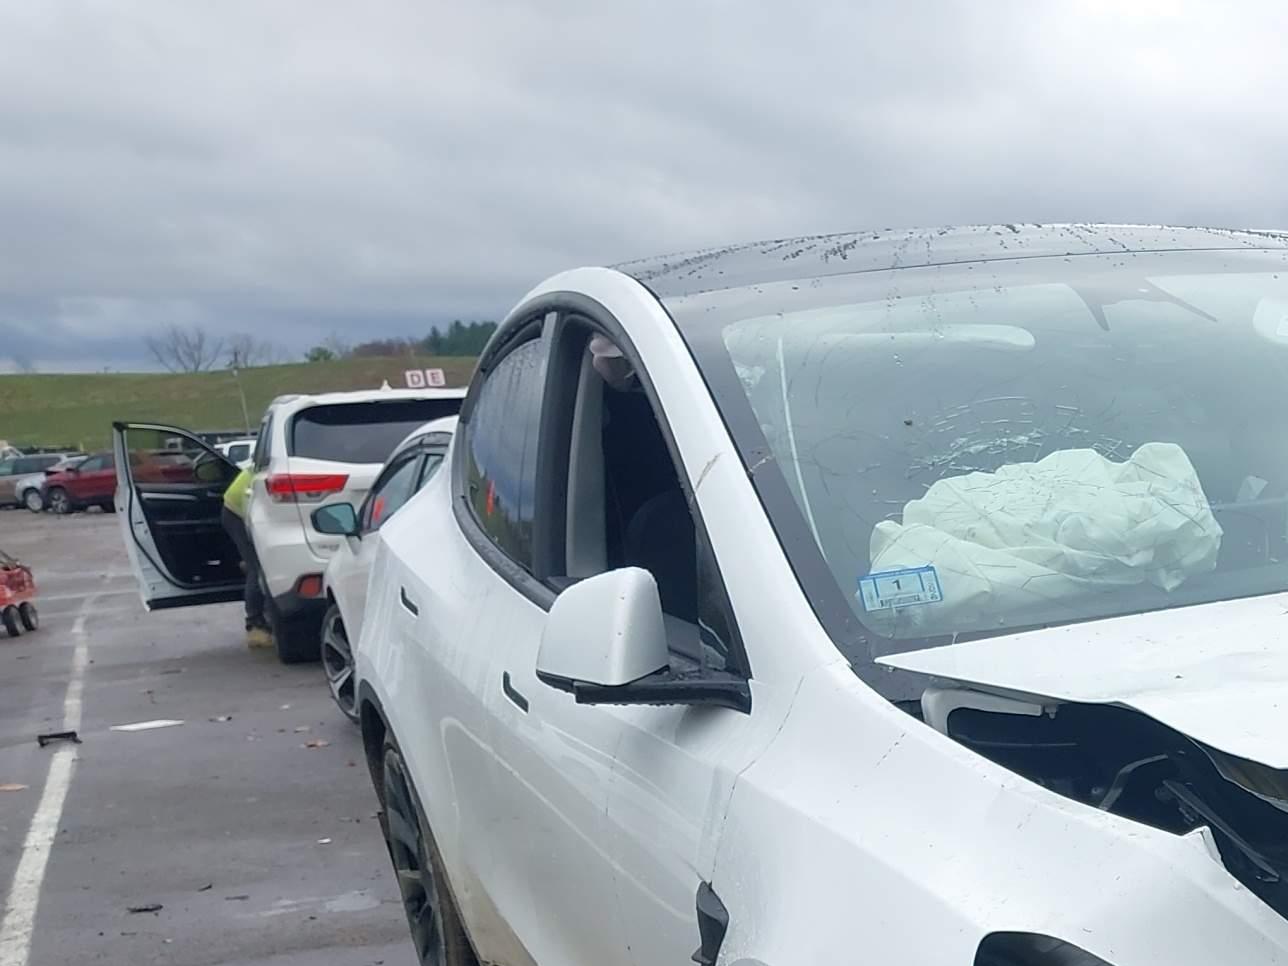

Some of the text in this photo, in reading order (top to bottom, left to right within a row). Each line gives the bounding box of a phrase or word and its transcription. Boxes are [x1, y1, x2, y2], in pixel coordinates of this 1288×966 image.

[410, 372, 441, 385] D E
[892, 579, 902, 591] 1
